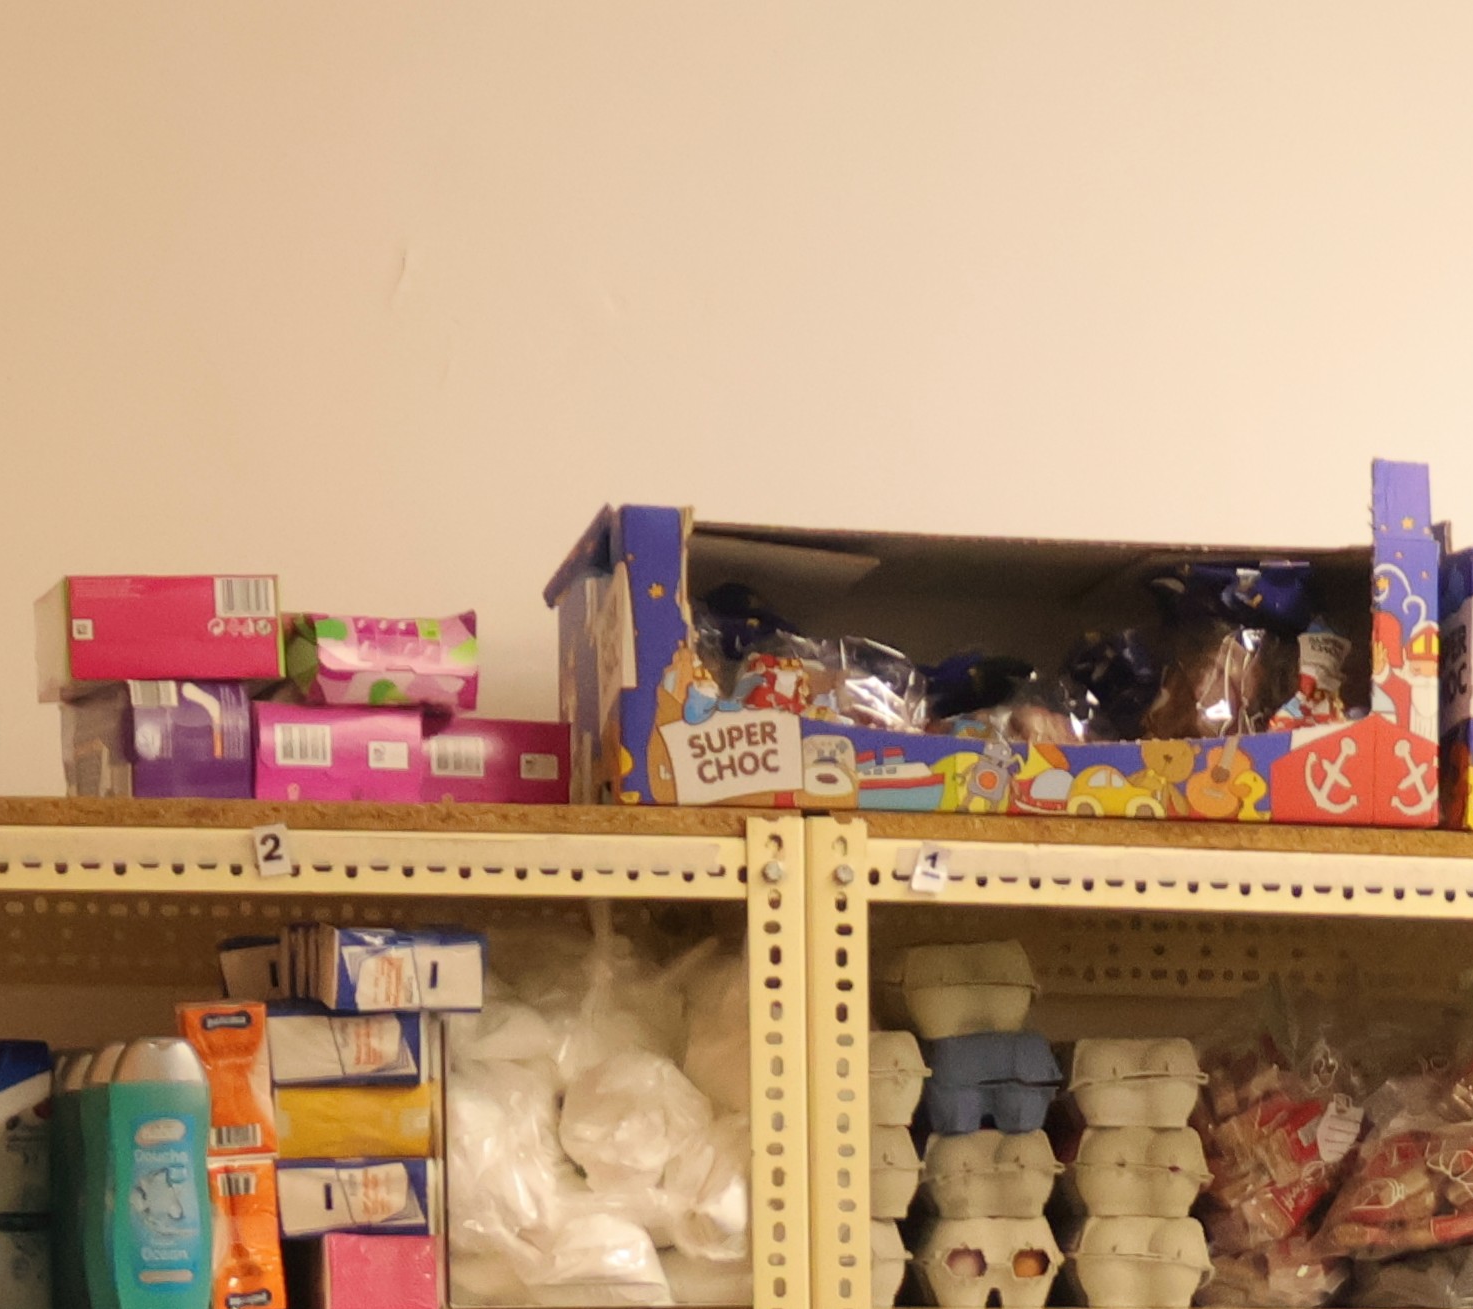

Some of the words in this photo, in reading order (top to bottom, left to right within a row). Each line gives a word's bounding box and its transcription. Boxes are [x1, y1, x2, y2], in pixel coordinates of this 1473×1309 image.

[687, 721, 779, 758] SUPER
[696, 748, 781, 785] CHOC
[261, 833, 283, 862] 2
